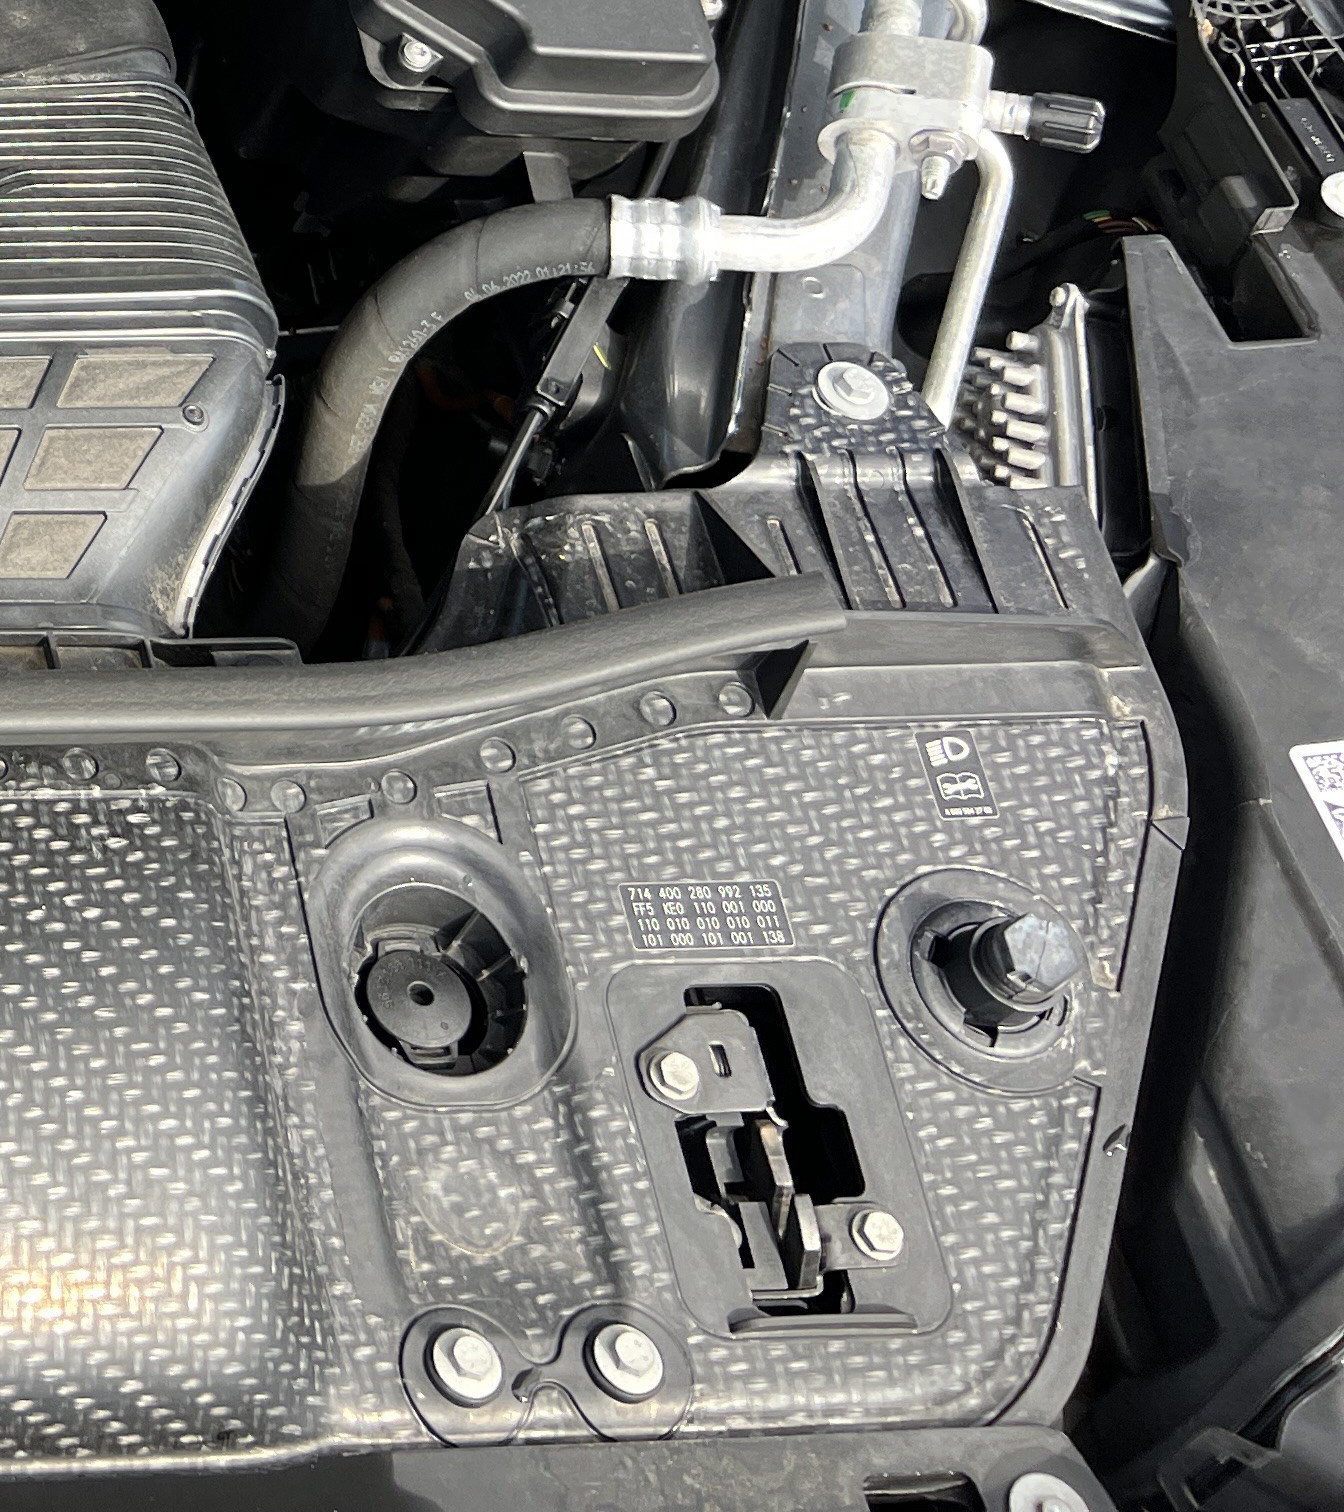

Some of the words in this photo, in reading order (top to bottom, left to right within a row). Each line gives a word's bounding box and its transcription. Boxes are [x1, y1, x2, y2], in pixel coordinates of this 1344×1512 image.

[628, 888, 651, 900] 714
[659, 887, 681, 899] 400
[688, 887, 711, 899] 280
[718, 886, 741, 898] 992
[750, 884, 772, 897] 135
[633, 904, 654, 916] FF5
[695, 902, 715, 914] 110
[723, 901, 744, 914] 001
[753, 900, 776, 913] 000
[638, 919, 659, 931] 110
[667, 918, 690, 931] 010
[697, 918, 720, 930] 010
[727, 917, 750, 929] 010
[757, 916, 780, 928] 011
[642, 934, 663, 946] 101
[671, 933, 694, 946] 000
[702, 933, 723, 945] 101
[731, 932, 753, 944] 001
[763, 931, 785, 943] 138
